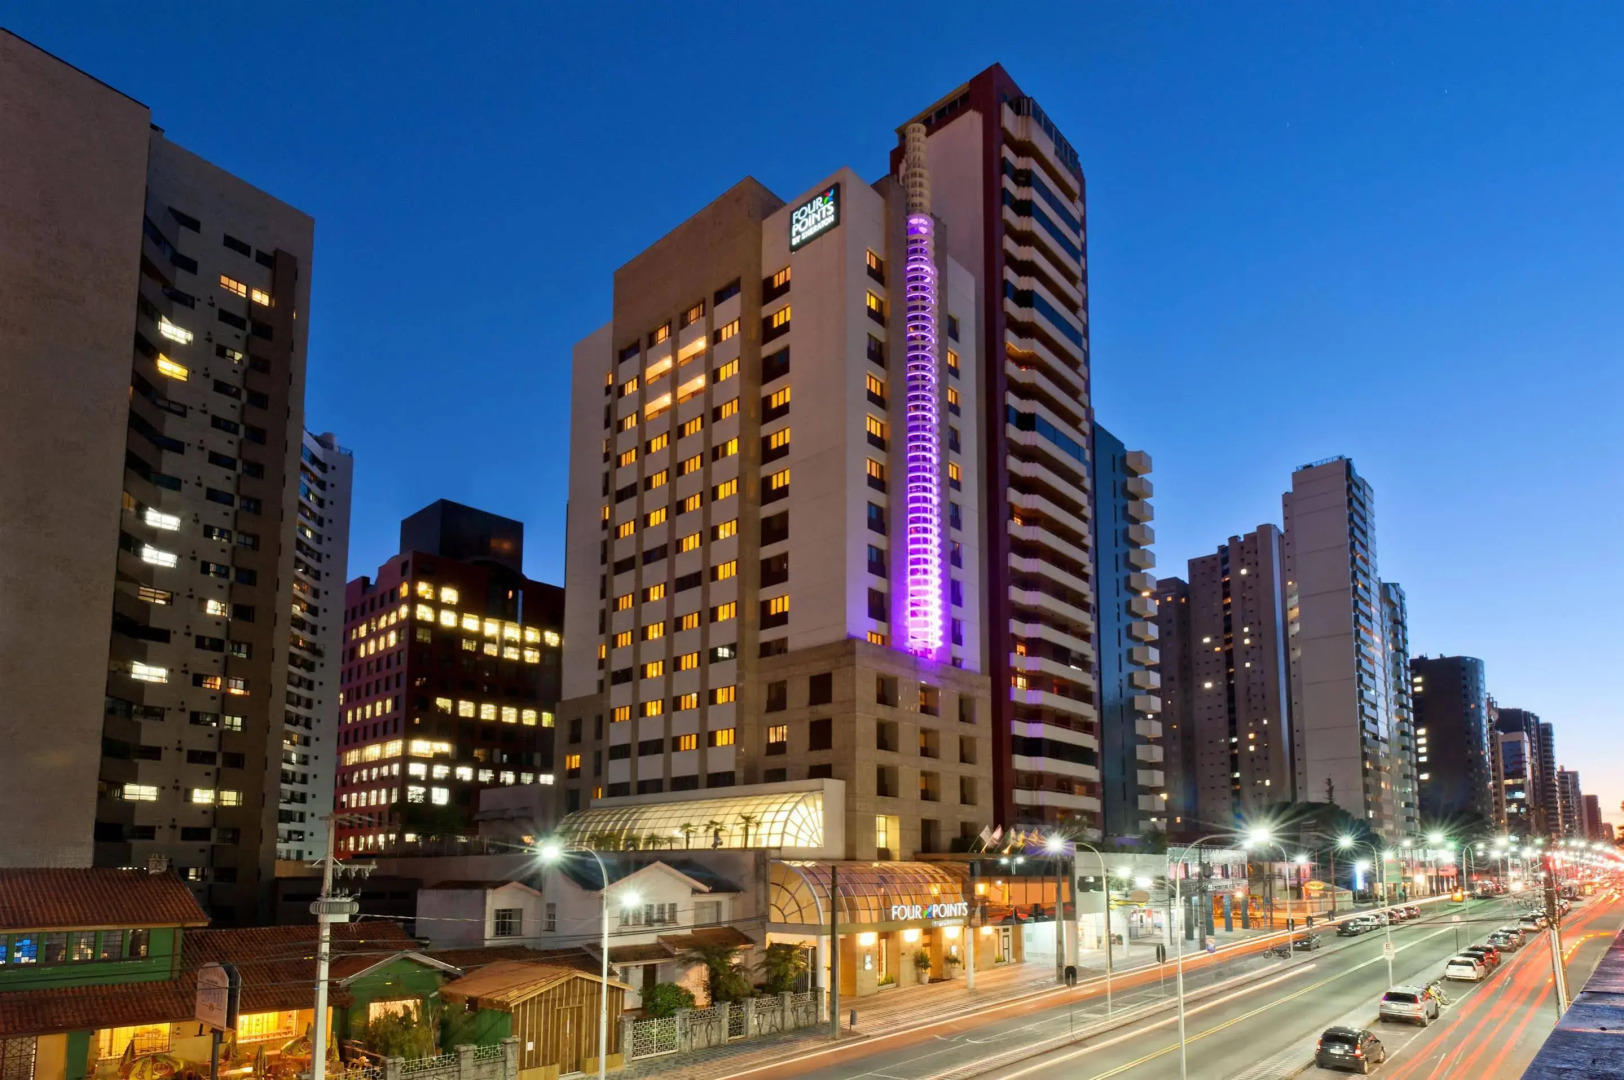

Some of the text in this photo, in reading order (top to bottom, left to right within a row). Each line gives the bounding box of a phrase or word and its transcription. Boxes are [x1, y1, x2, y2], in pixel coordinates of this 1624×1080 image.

[792, 201, 834, 237] POINTS
[793, 197, 823, 224] FOUR
[792, 215, 834, 246] BY SHERATON
[891, 902, 968, 920] FOUR POINTS
